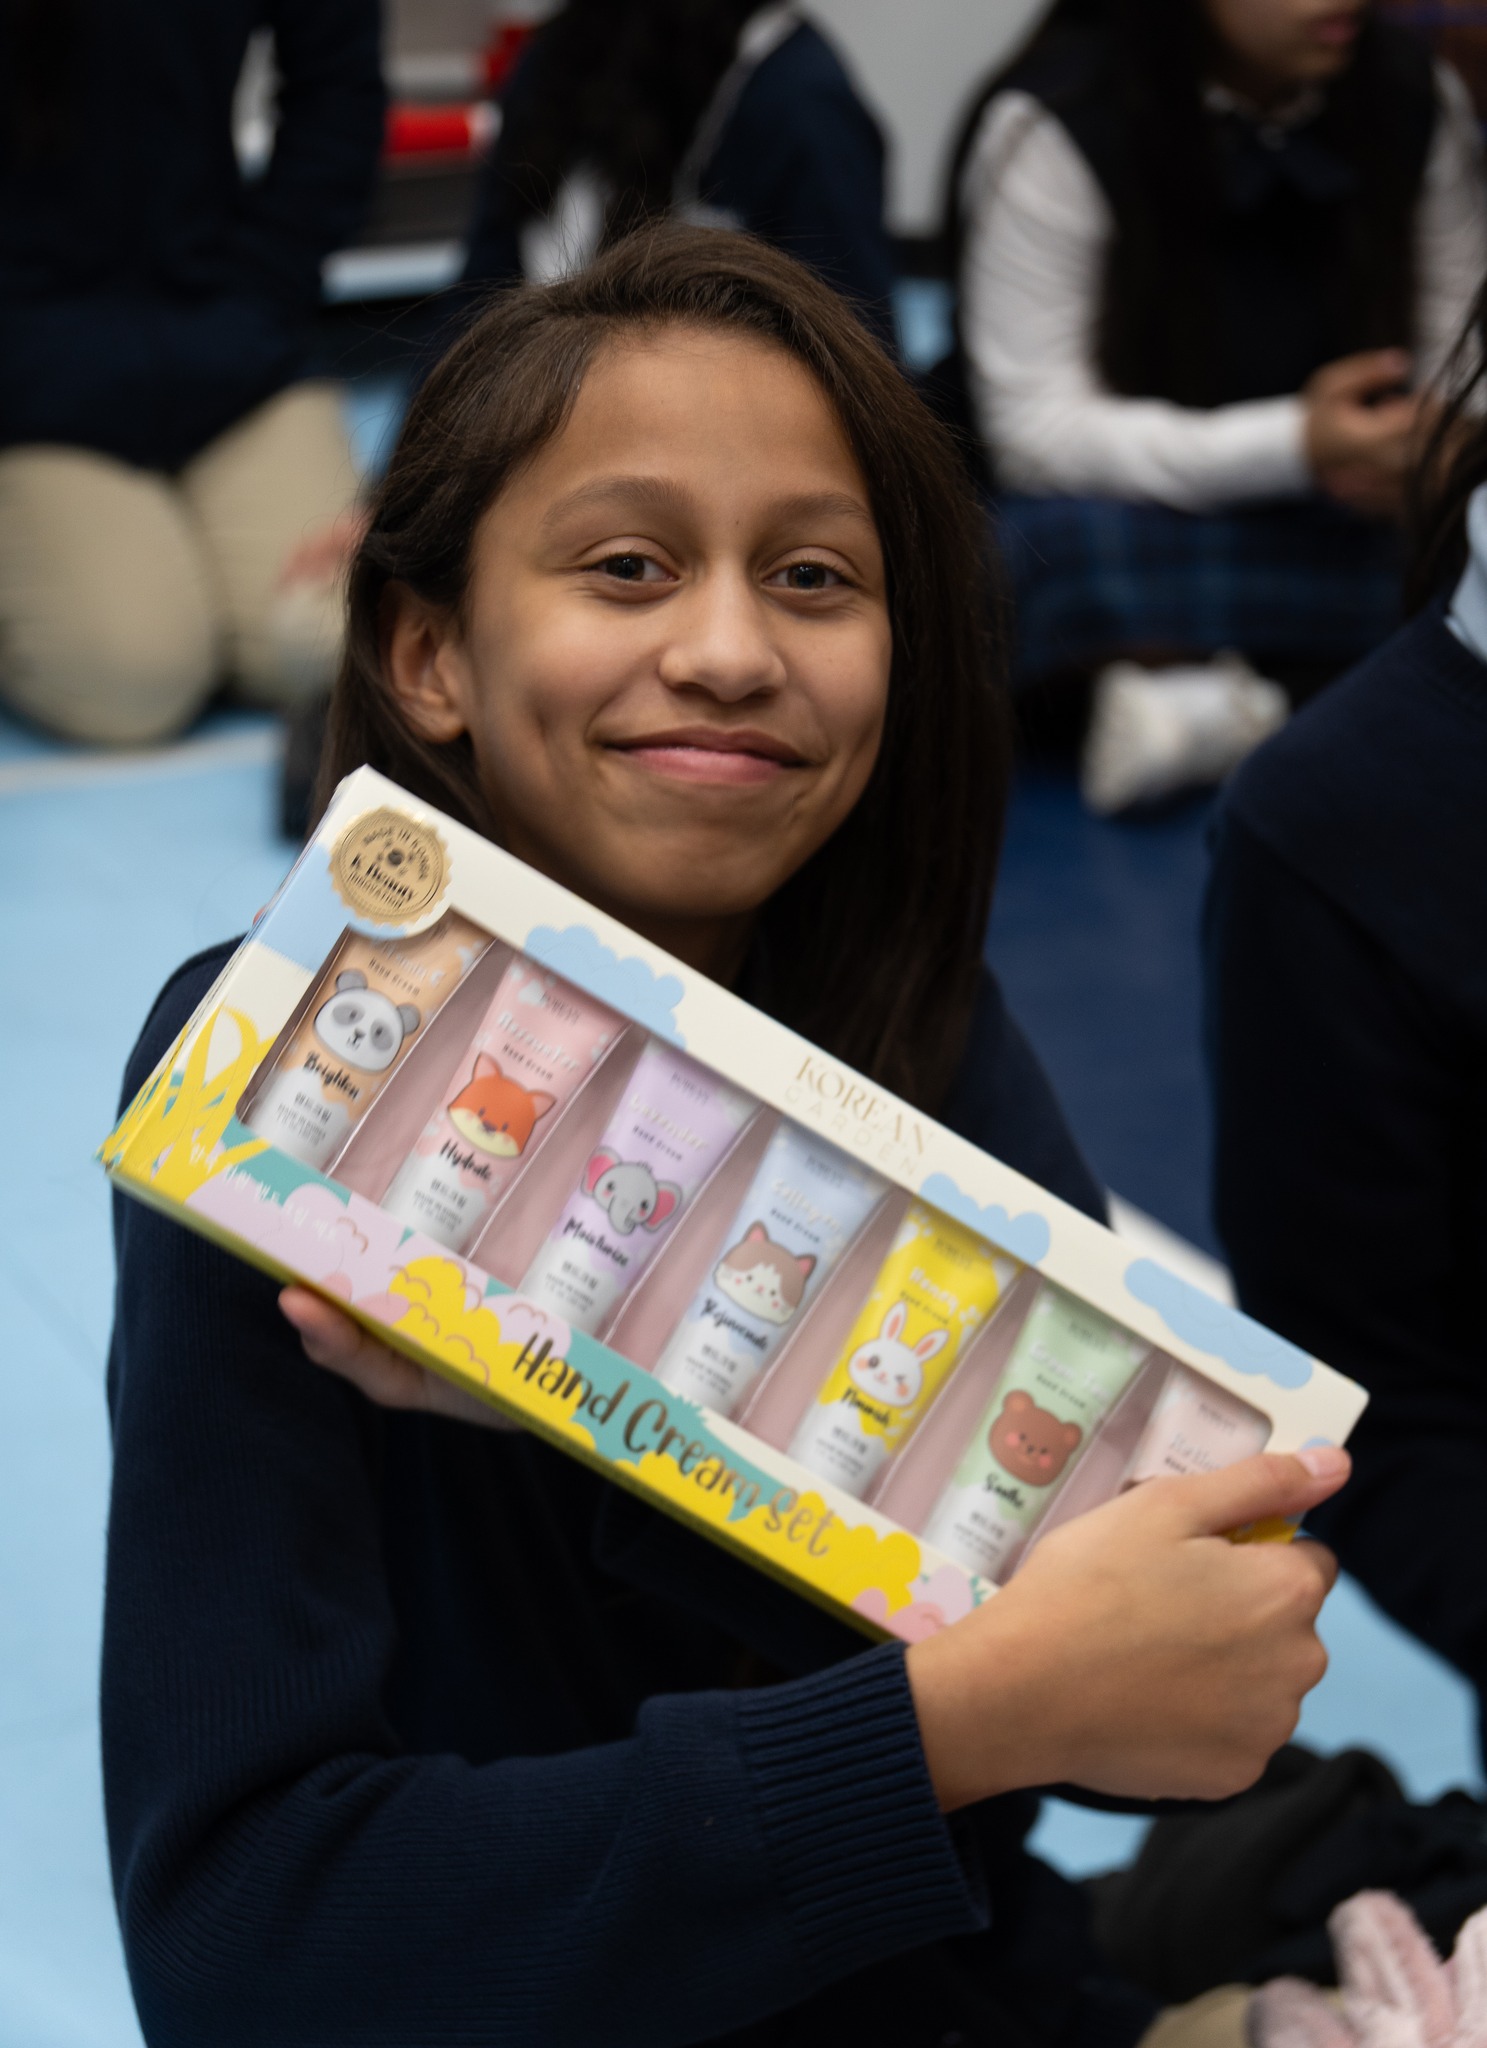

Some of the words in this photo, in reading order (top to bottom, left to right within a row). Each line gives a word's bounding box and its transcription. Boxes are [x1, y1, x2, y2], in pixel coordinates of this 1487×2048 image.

[303, 1051, 361, 1102] Brighten
[785, 1085, 919, 1176] GARDEN
[796, 1056, 934, 1156] KOREAN
[440, 1138, 492, 1181] Hydrate
[562, 1216, 629, 1268] Moisturize
[909, 1267, 959, 1314] Honey
[701, 1297, 769, 1351] Rejuvenate
[513, 1332, 631, 1425] Hand
[623, 1398, 760, 1509] Cream
[841, 1387, 891, 1428] Nourish
